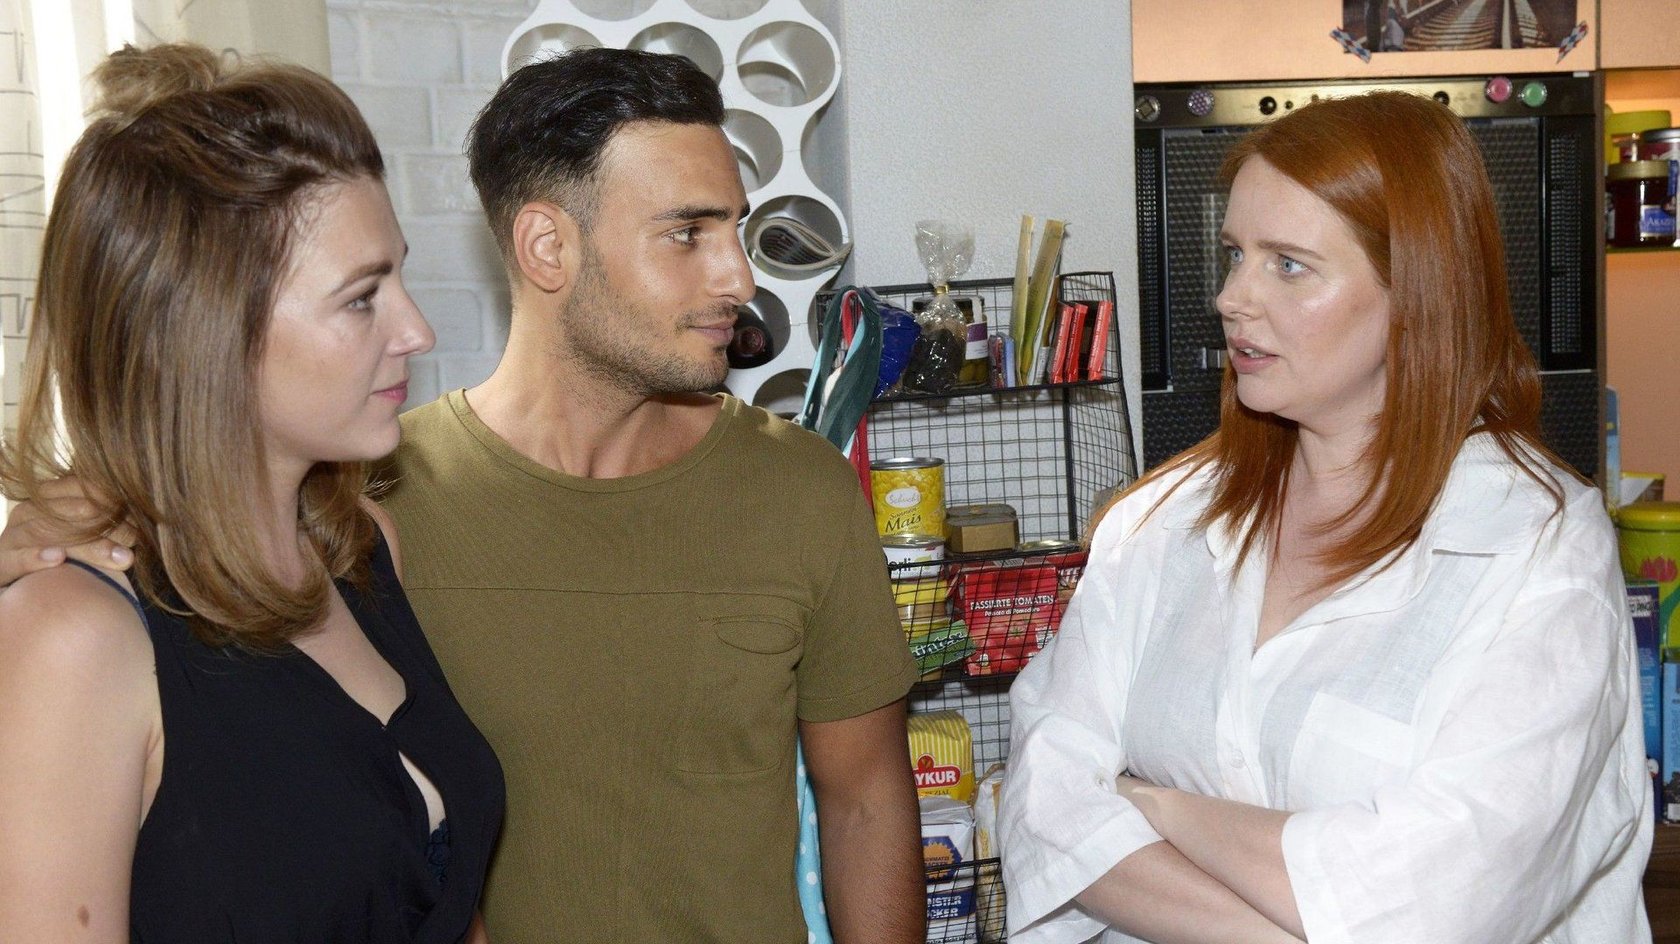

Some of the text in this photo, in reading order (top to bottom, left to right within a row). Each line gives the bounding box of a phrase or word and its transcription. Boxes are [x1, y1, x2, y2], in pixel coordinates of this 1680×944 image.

[885, 513, 922, 533] Mais
[1013, 594, 1055, 606] TOMATEN
[984, 608, 1005, 617] Pasata
